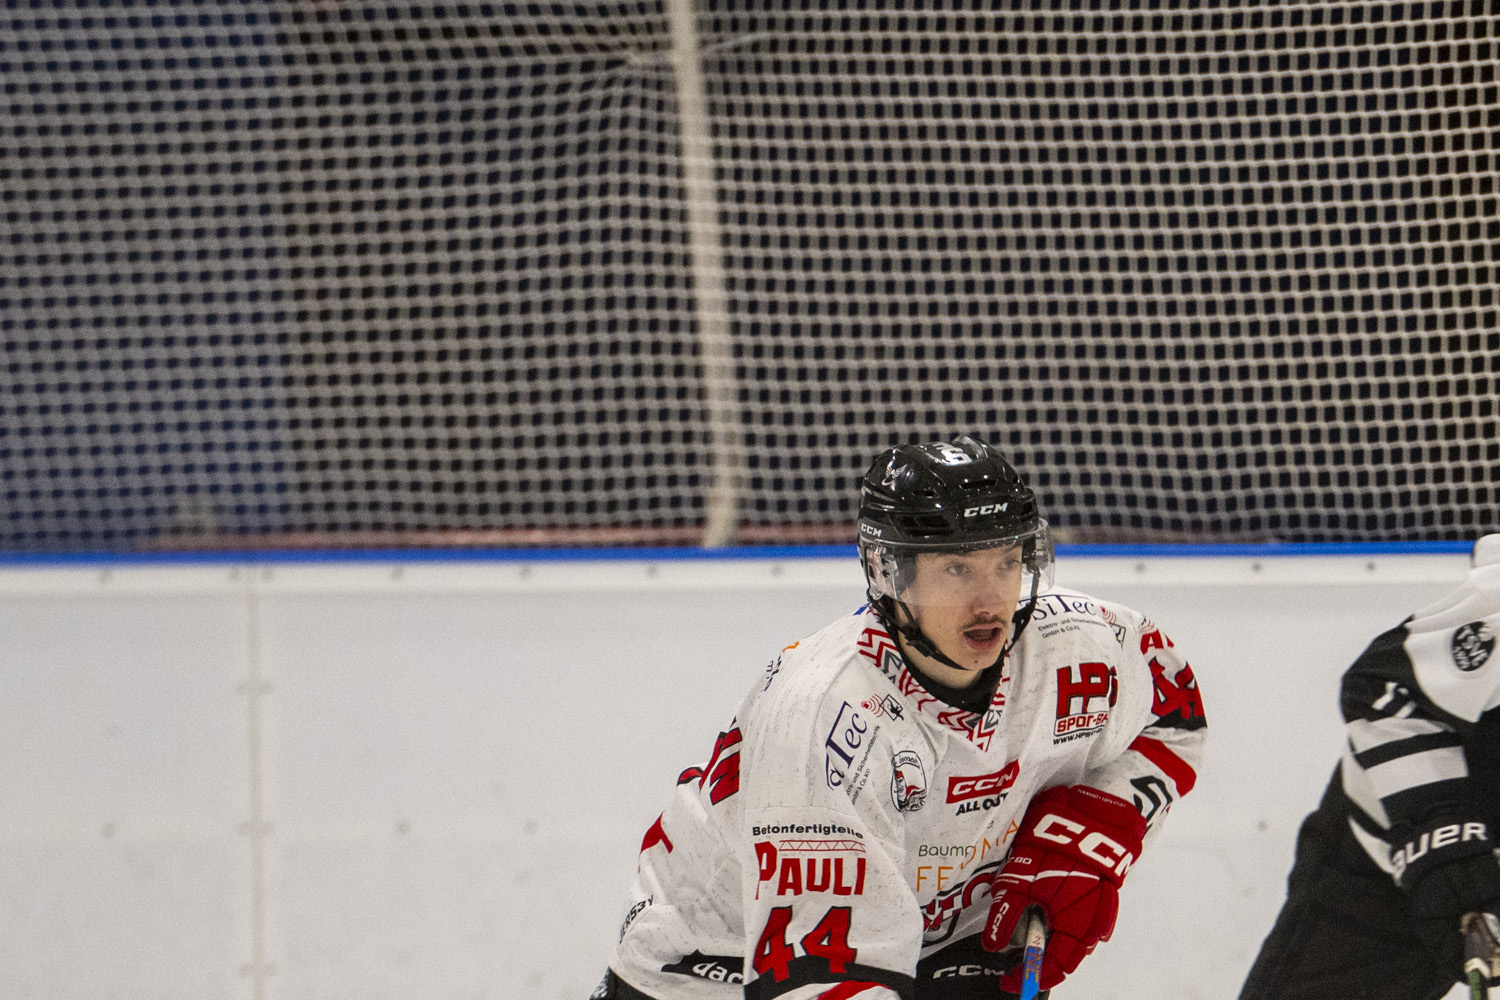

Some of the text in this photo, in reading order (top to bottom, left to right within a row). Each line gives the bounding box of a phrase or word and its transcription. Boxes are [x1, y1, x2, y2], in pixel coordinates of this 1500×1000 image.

[963, 502, 1009, 518] CCM
[860, 523, 883, 537] CCM
[955, 799, 981, 816] ALL
[752, 824, 864, 839] Betonfertigteile
[754, 841, 867, 900] PAULI
[990, 901, 1010, 942] CCM
[753, 905, 858, 982] 44
[692, 962, 744, 984] dac
